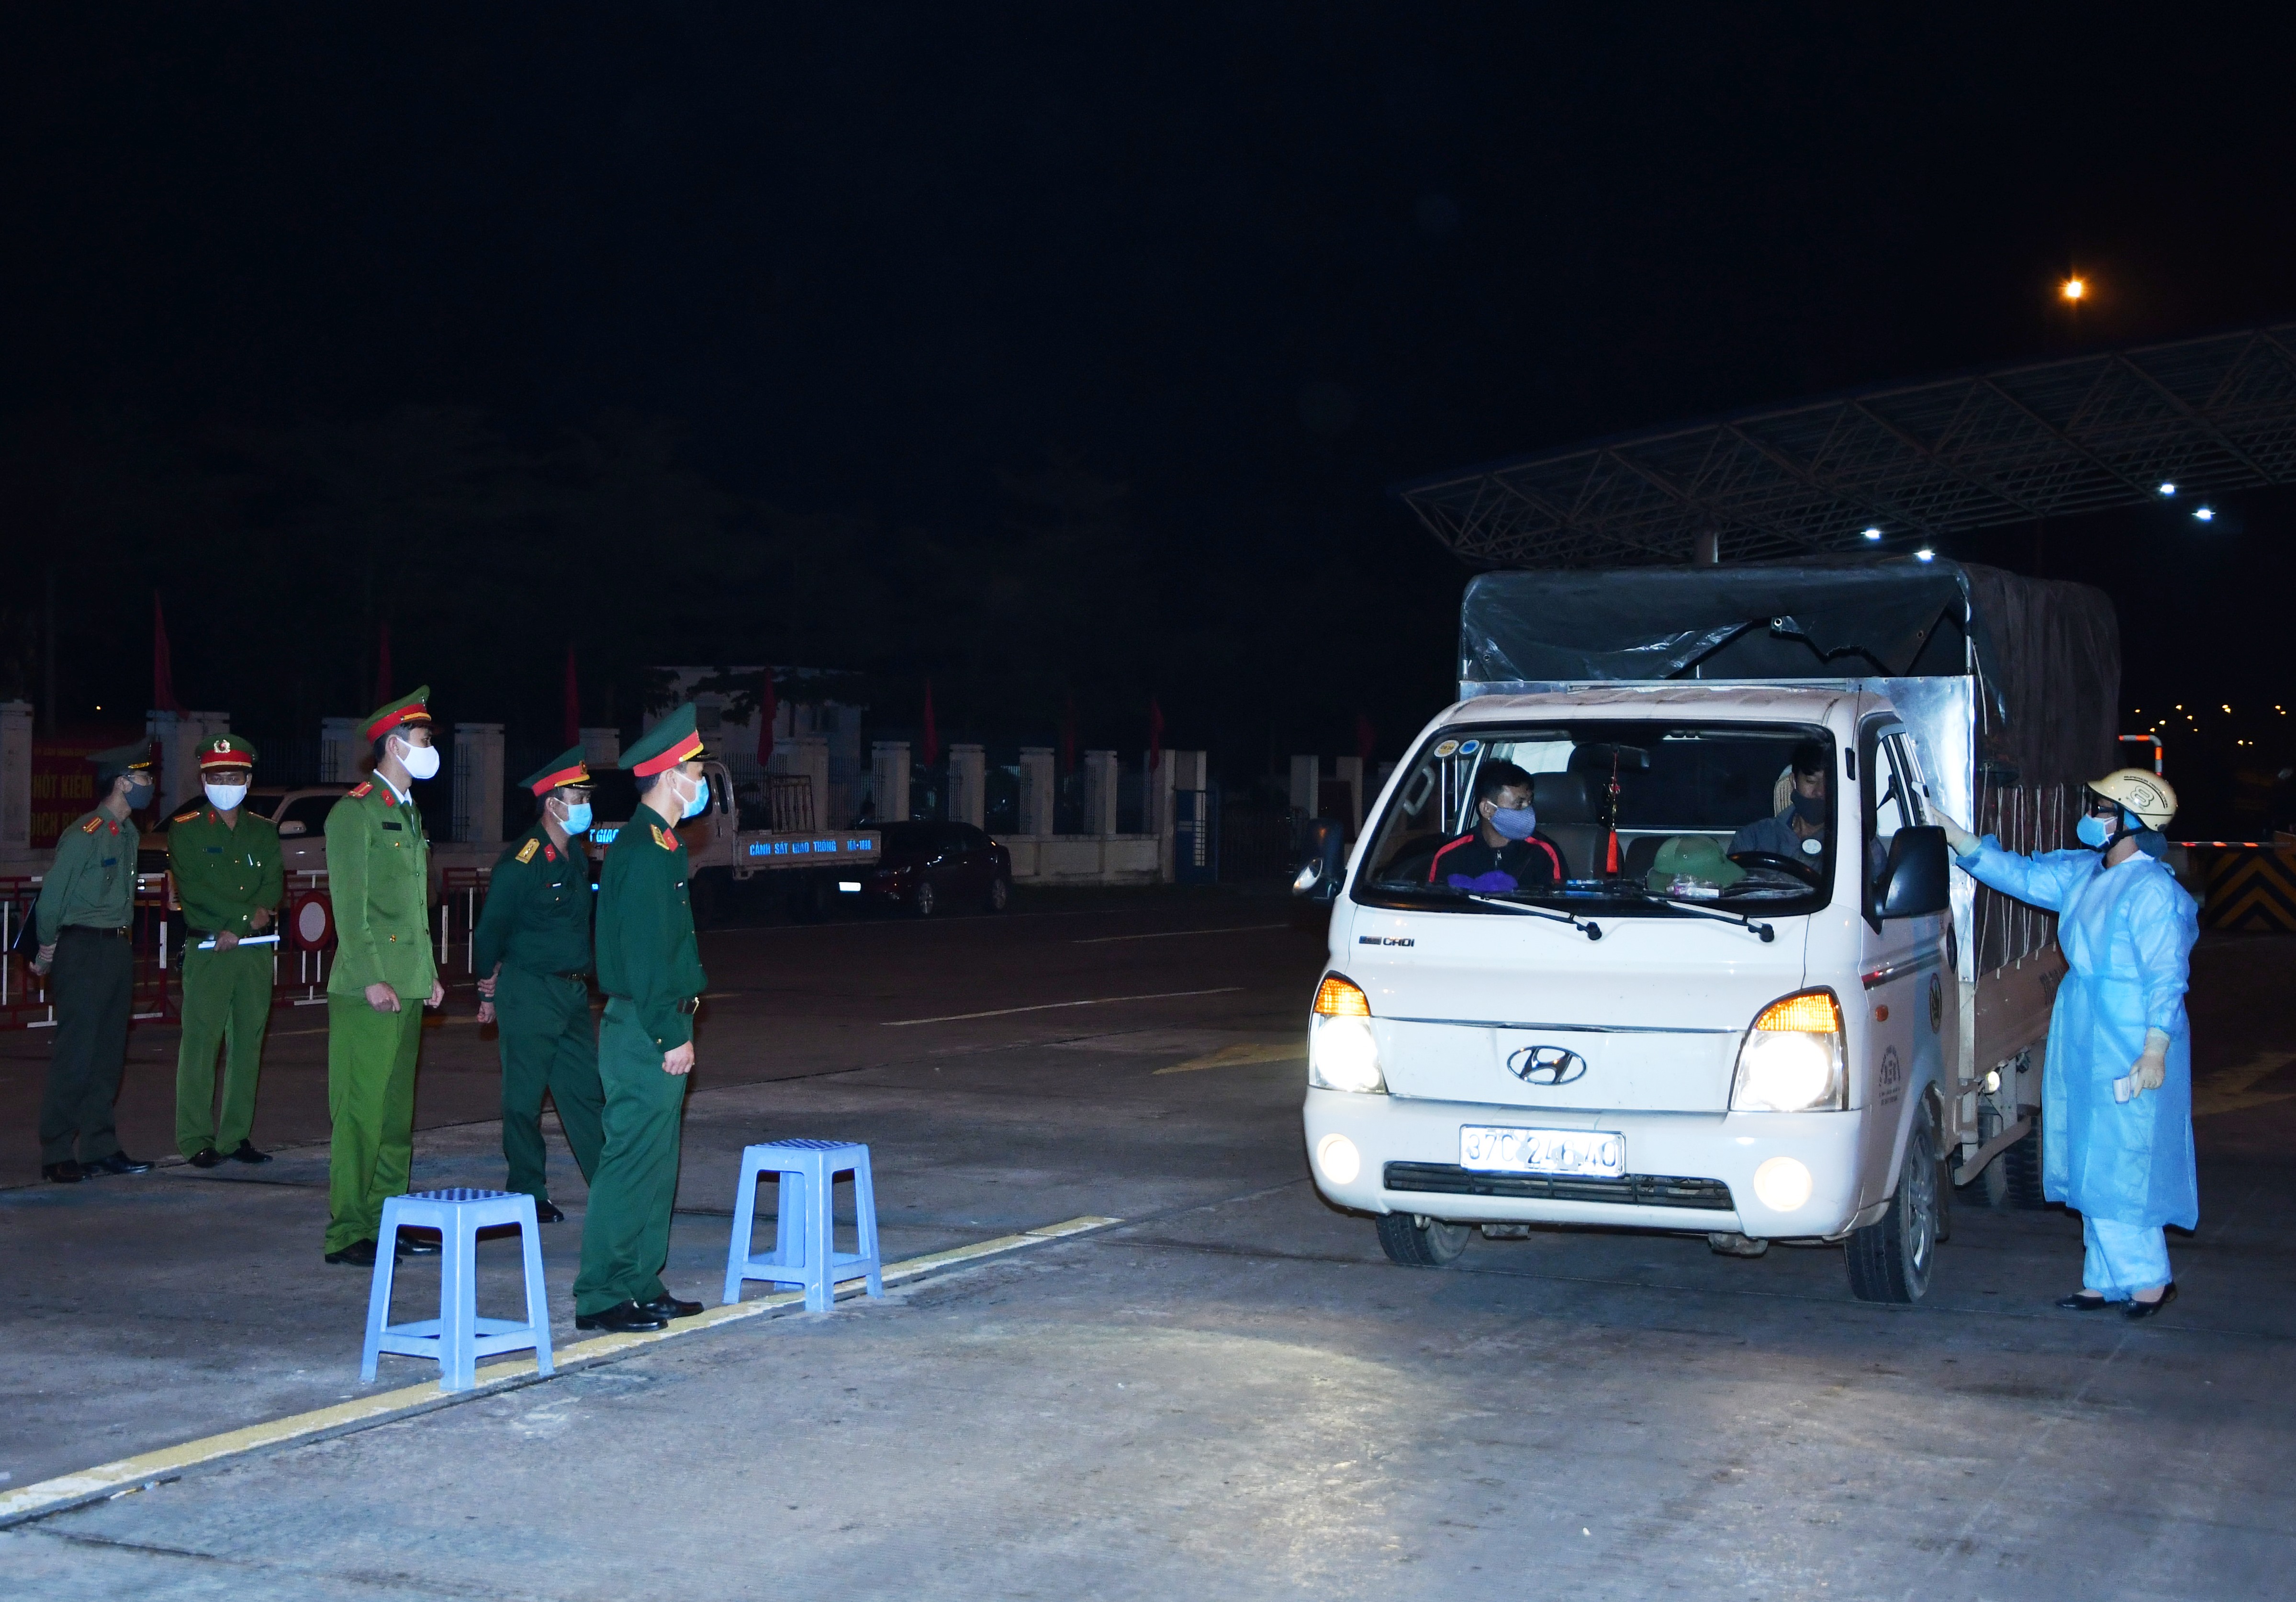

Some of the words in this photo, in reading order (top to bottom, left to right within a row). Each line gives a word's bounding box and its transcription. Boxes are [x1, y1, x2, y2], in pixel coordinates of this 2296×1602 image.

[31, 768, 57, 799] HỐT
[750, 841, 771, 855] CẢNH
[774, 841, 788, 854] SÁT
[793, 841, 809, 853] GIAO
[813, 840, 837, 852] THÔNG
